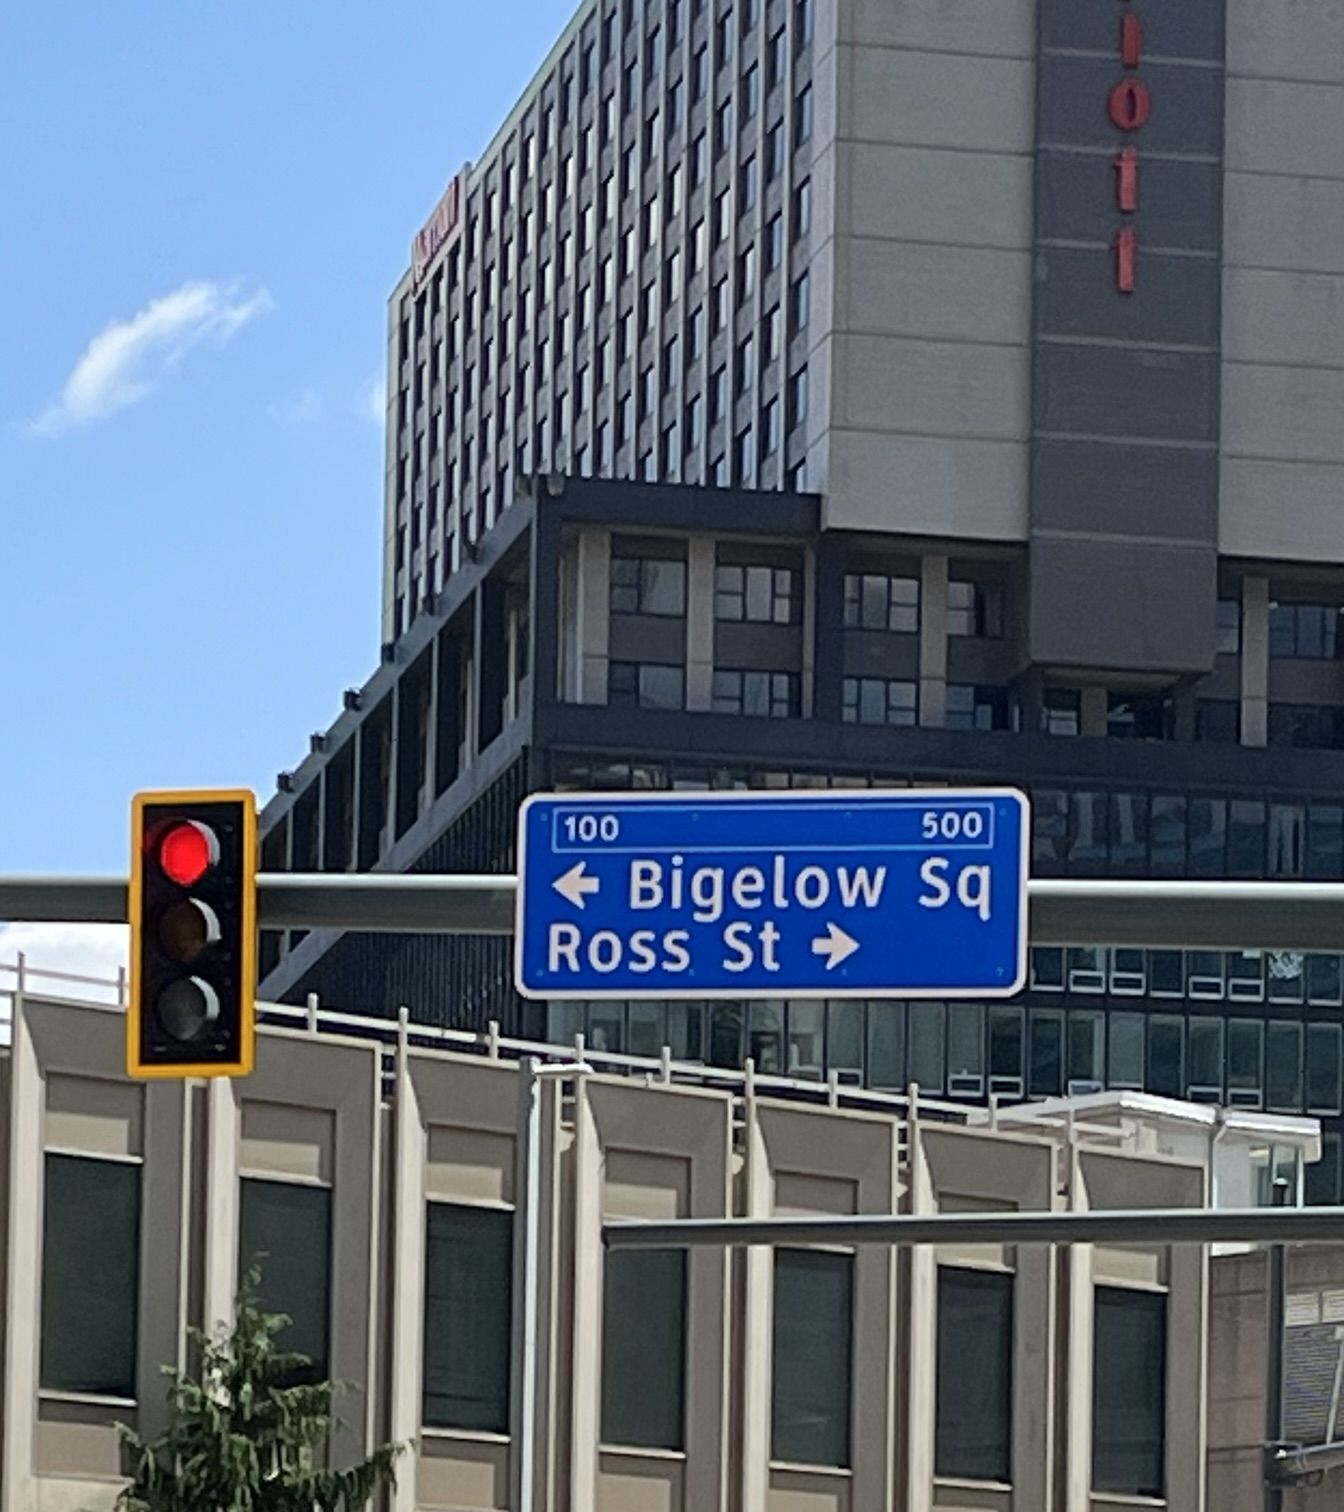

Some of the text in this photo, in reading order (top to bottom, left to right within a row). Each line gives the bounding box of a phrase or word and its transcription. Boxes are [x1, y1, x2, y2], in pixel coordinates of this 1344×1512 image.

[564, 815, 619, 842] 100
[921, 811, 983, 840] 500
[629, 855, 991, 923] Bigelow Sq
[548, 920, 781, 973] Ross St
